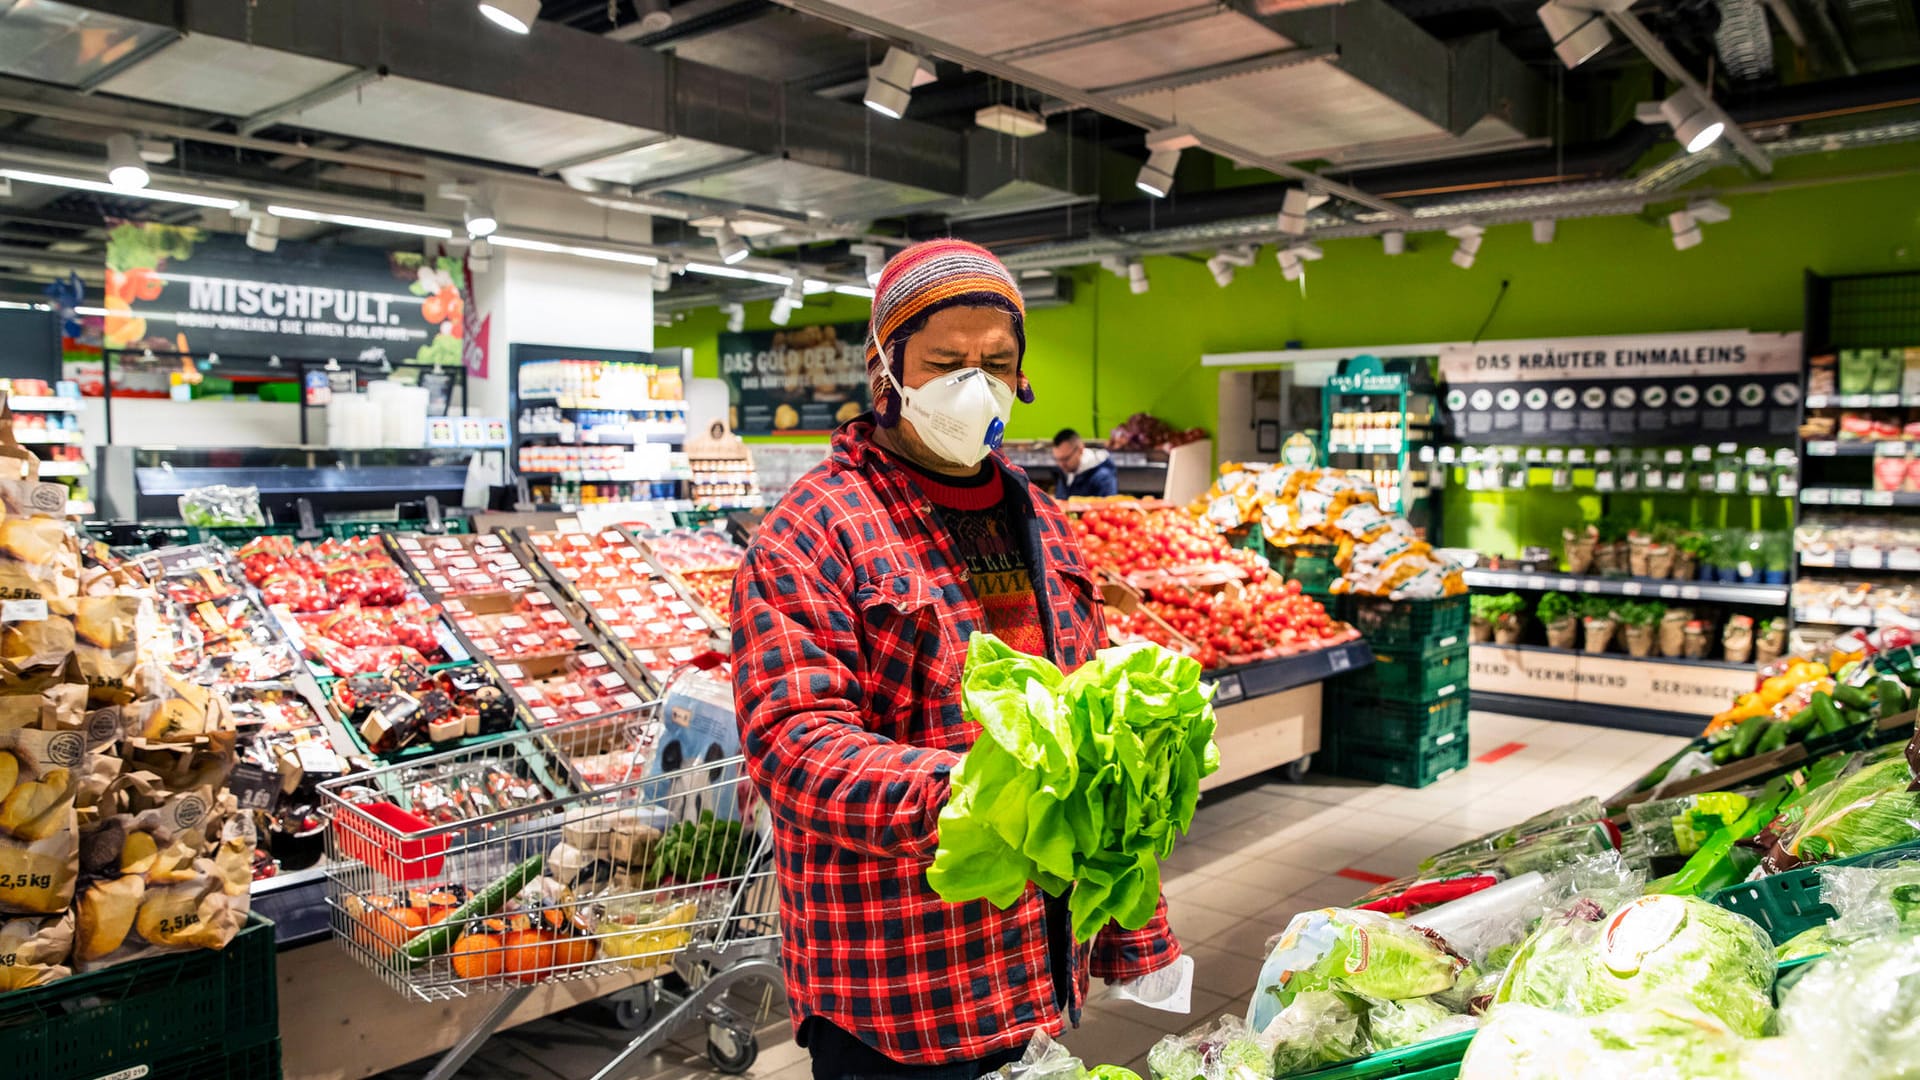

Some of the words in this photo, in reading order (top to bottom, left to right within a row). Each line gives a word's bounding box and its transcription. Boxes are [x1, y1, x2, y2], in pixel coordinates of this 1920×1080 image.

[189, 279, 400, 325] MISCHPULT.
[279, 319, 303, 335] SIE
[304, 321, 345, 337] IHREN
[724, 352, 753, 374] DAS
[757, 350, 800, 373] GOLD
[803, 346, 836, 369] DER
[844, 343, 866, 367] ER
[1476, 354, 1511, 371] DAS
[1518, 347, 1607, 370] KRÄUTER
[1614, 345, 1747, 368] EINMALEINS
[1474, 662, 1511, 675] REND
[1652, 678, 1751, 699] BERUHIGEN
[0, 874, 27, 890] 2,5
[30, 873, 51, 889] kg
[159, 915, 183, 934] 2,5
